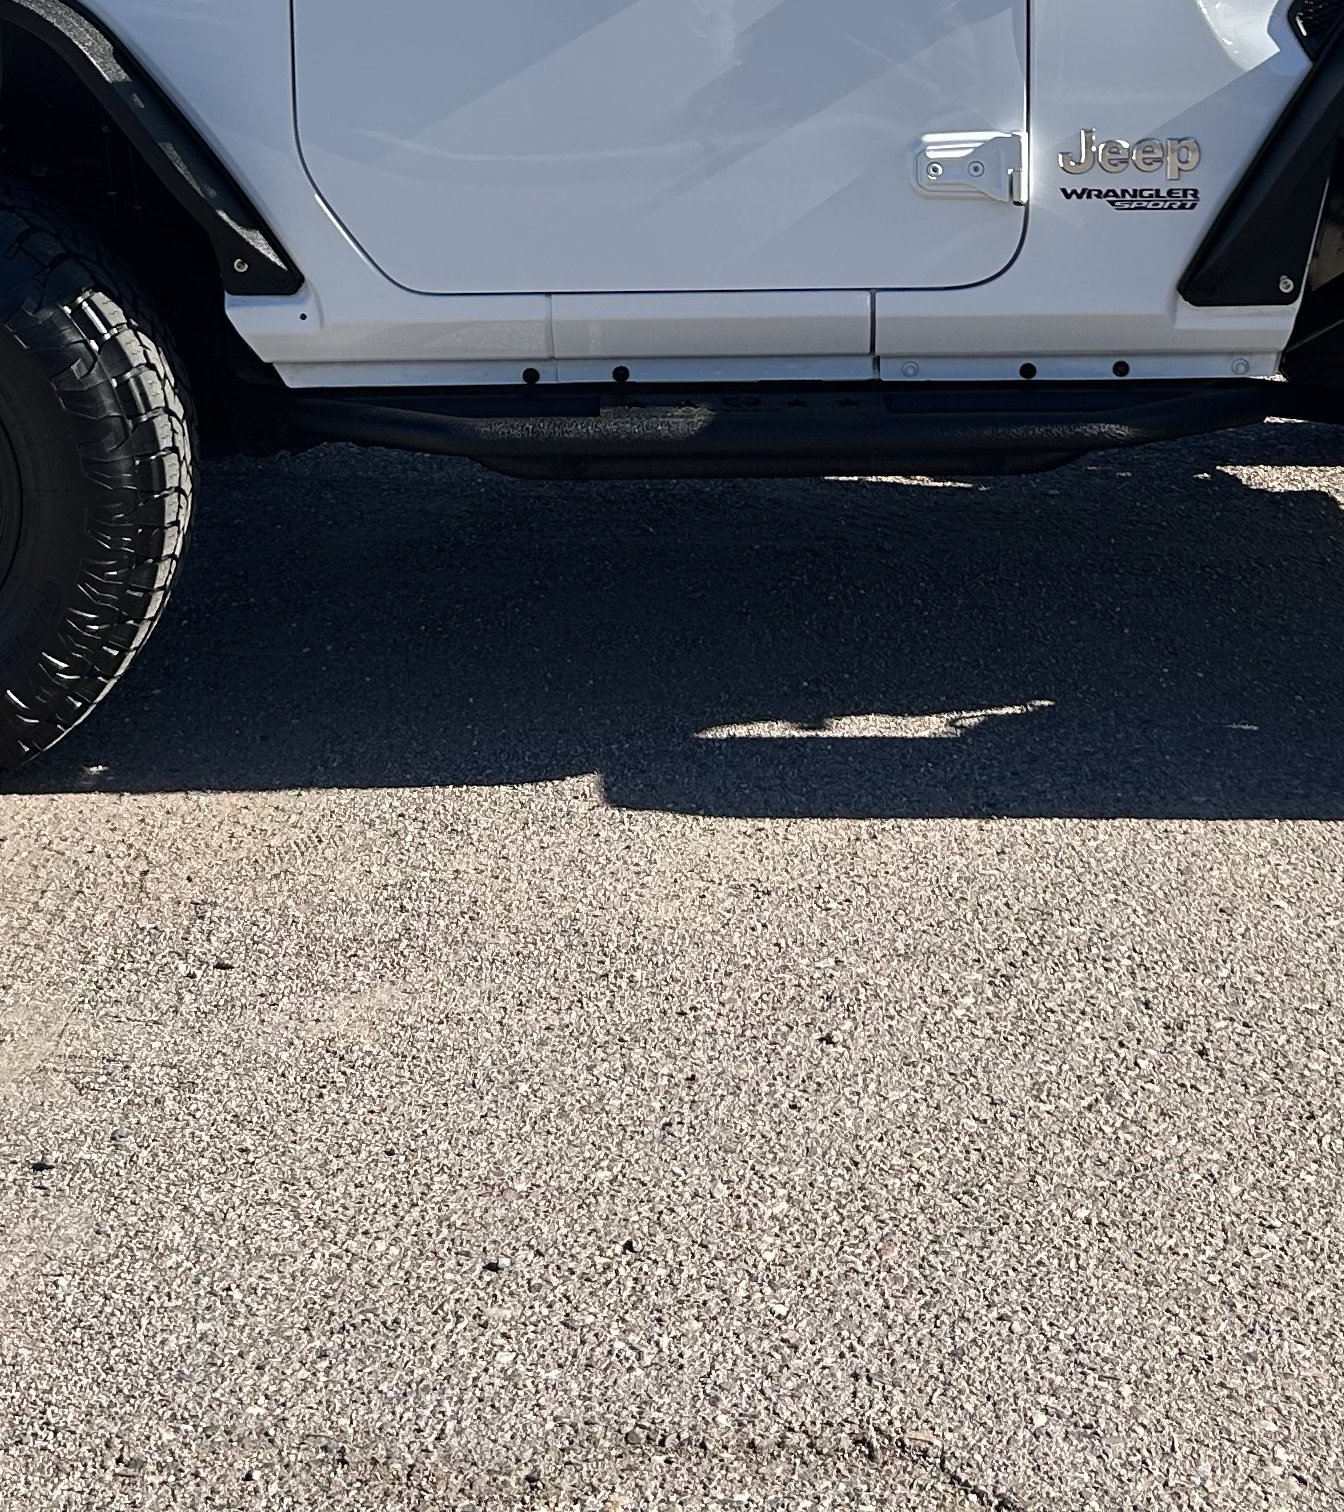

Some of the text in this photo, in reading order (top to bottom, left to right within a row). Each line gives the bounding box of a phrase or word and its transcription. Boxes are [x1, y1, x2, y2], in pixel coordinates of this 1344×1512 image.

[1057, 127, 1202, 181] Jeep
[1059, 187, 1200, 200] WRANGLER
[1111, 200, 1199, 210] SPORT
